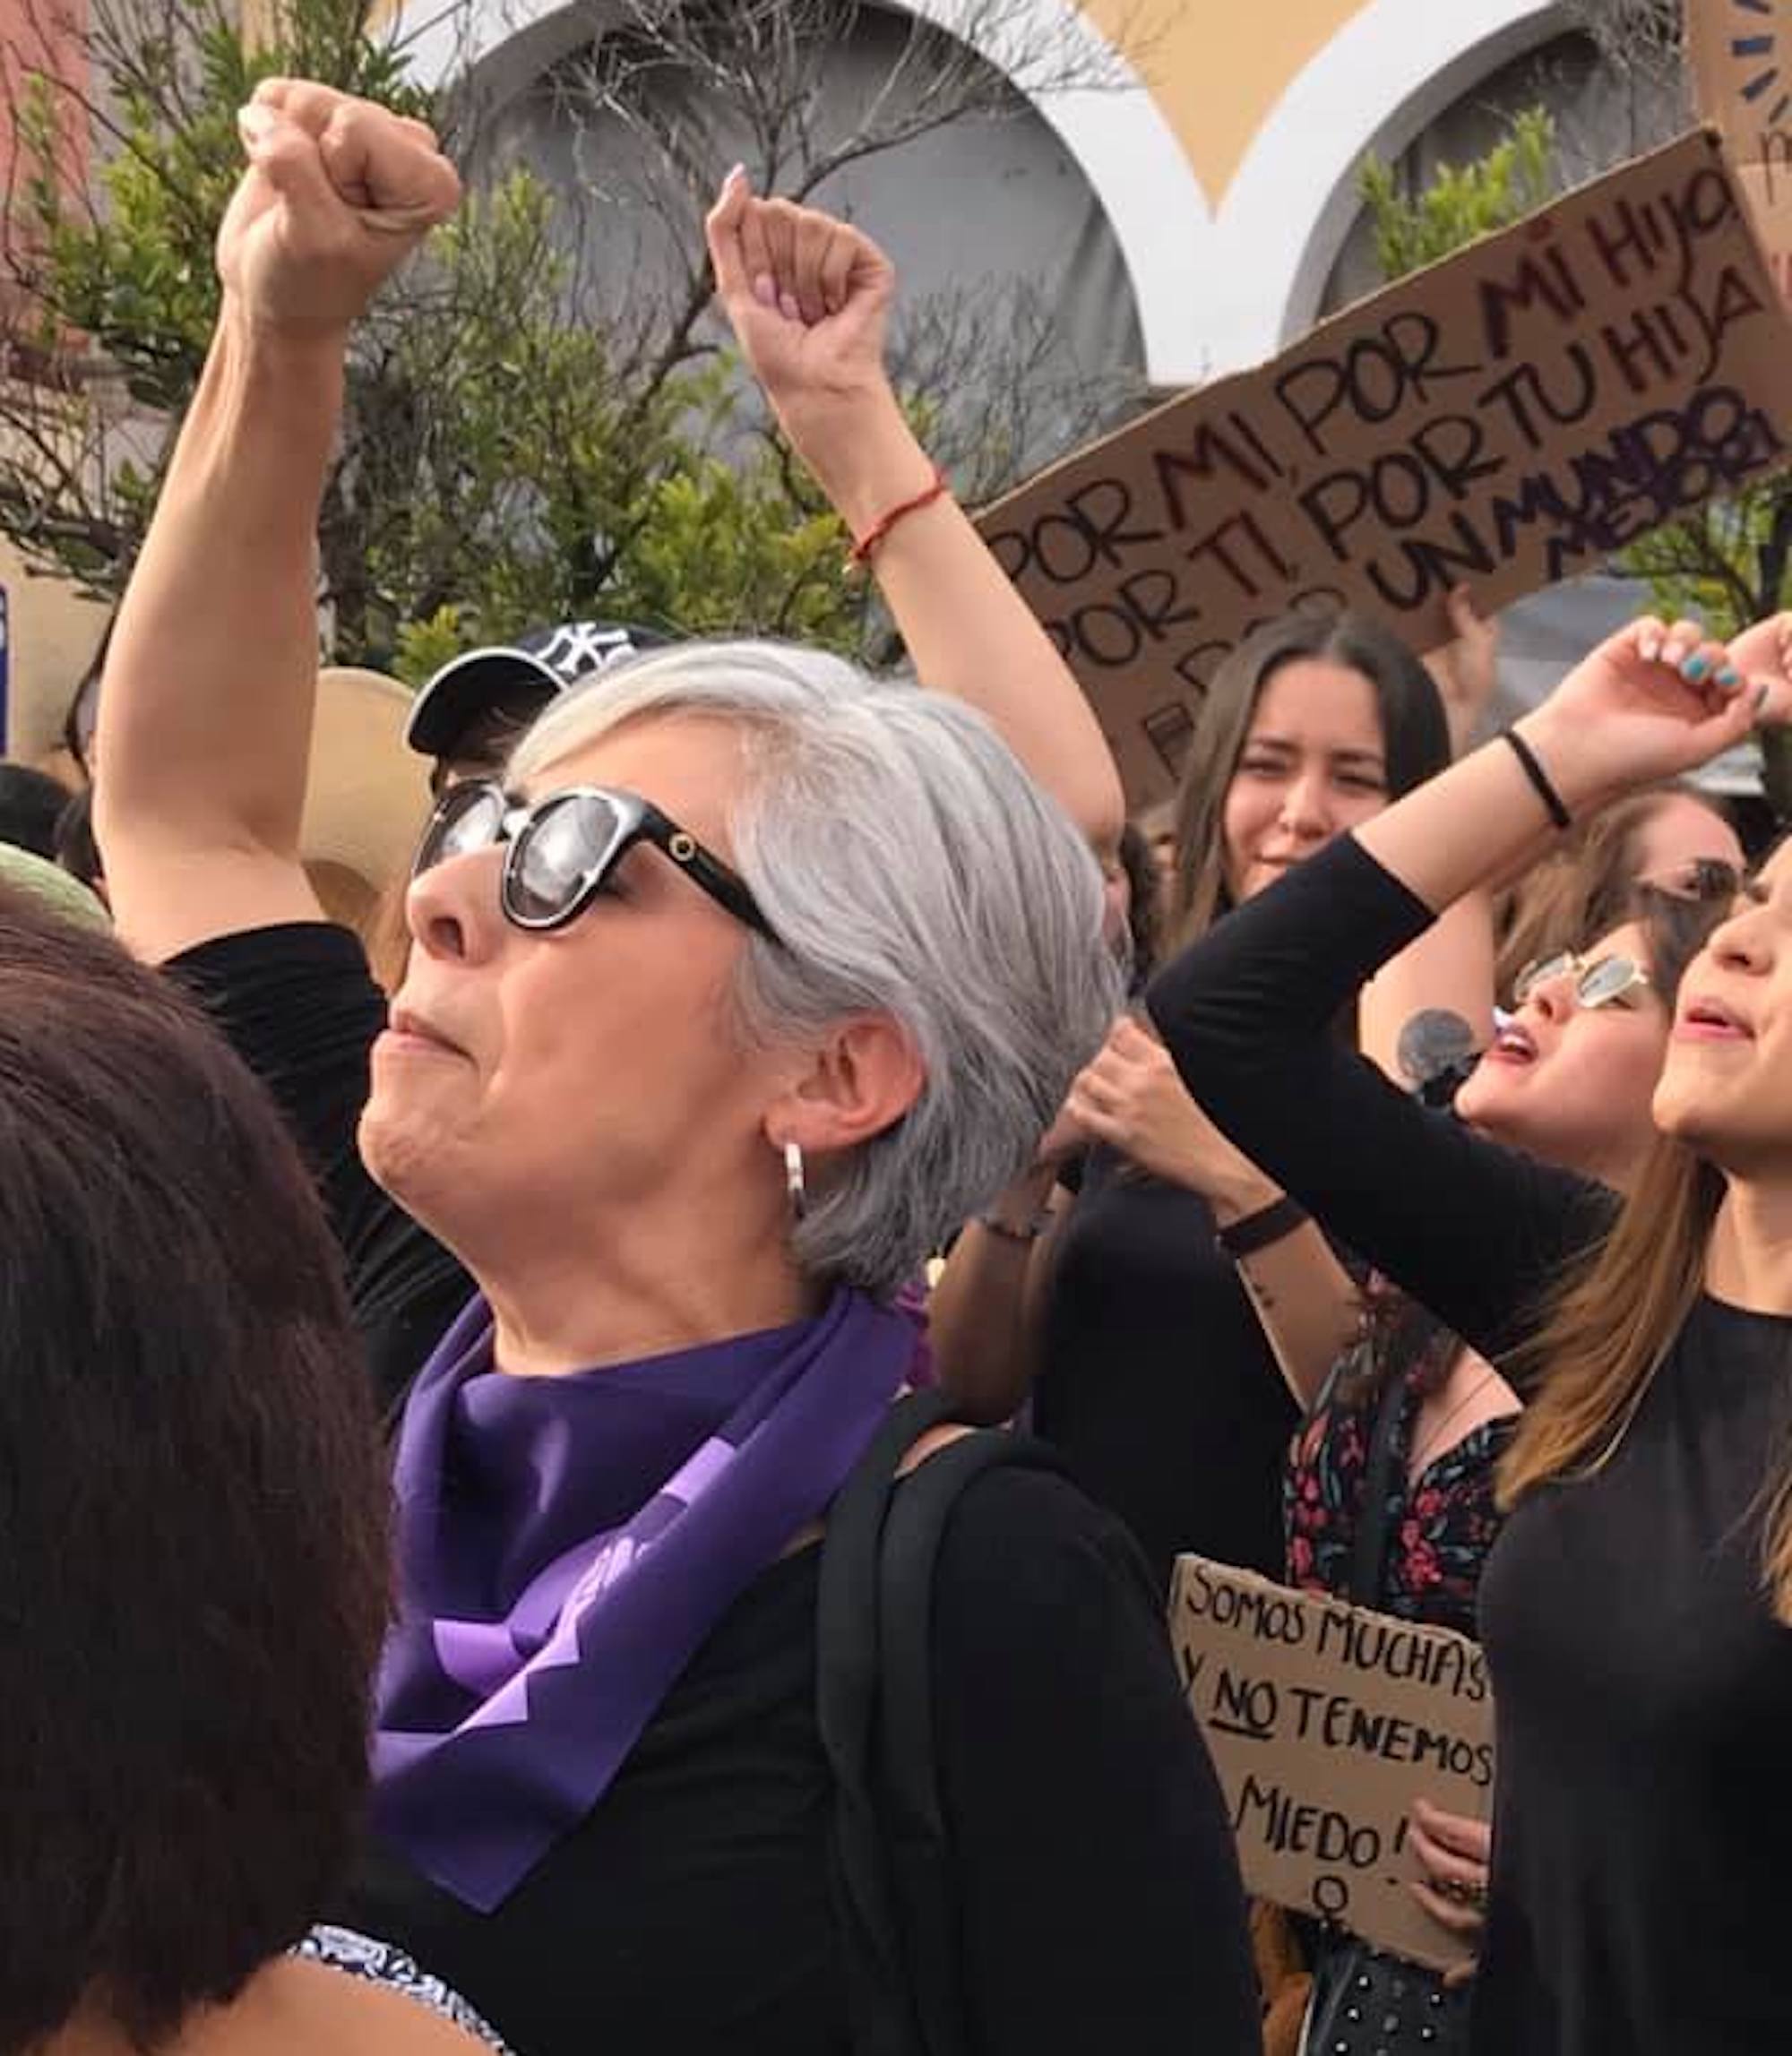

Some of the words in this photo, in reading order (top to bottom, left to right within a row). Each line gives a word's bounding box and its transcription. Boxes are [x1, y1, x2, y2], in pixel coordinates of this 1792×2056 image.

[1275, 312, 1484, 456] POR
[1298, 414, 1508, 563] POR
[1478, 342, 1596, 448] TU
[1601, 264, 1764, 394] HIJA
[1366, 512, 1497, 612] UN
[1493, 383, 1748, 558] MUNDO
[1186, 1564, 1305, 1643] SOMOS
[1316, 1610, 1486, 1700] MUCHAS
[1182, 1644, 1206, 1695] Y
[1213, 1669, 1277, 1729] NO
[1288, 1687, 1494, 1786] TENEMOS
